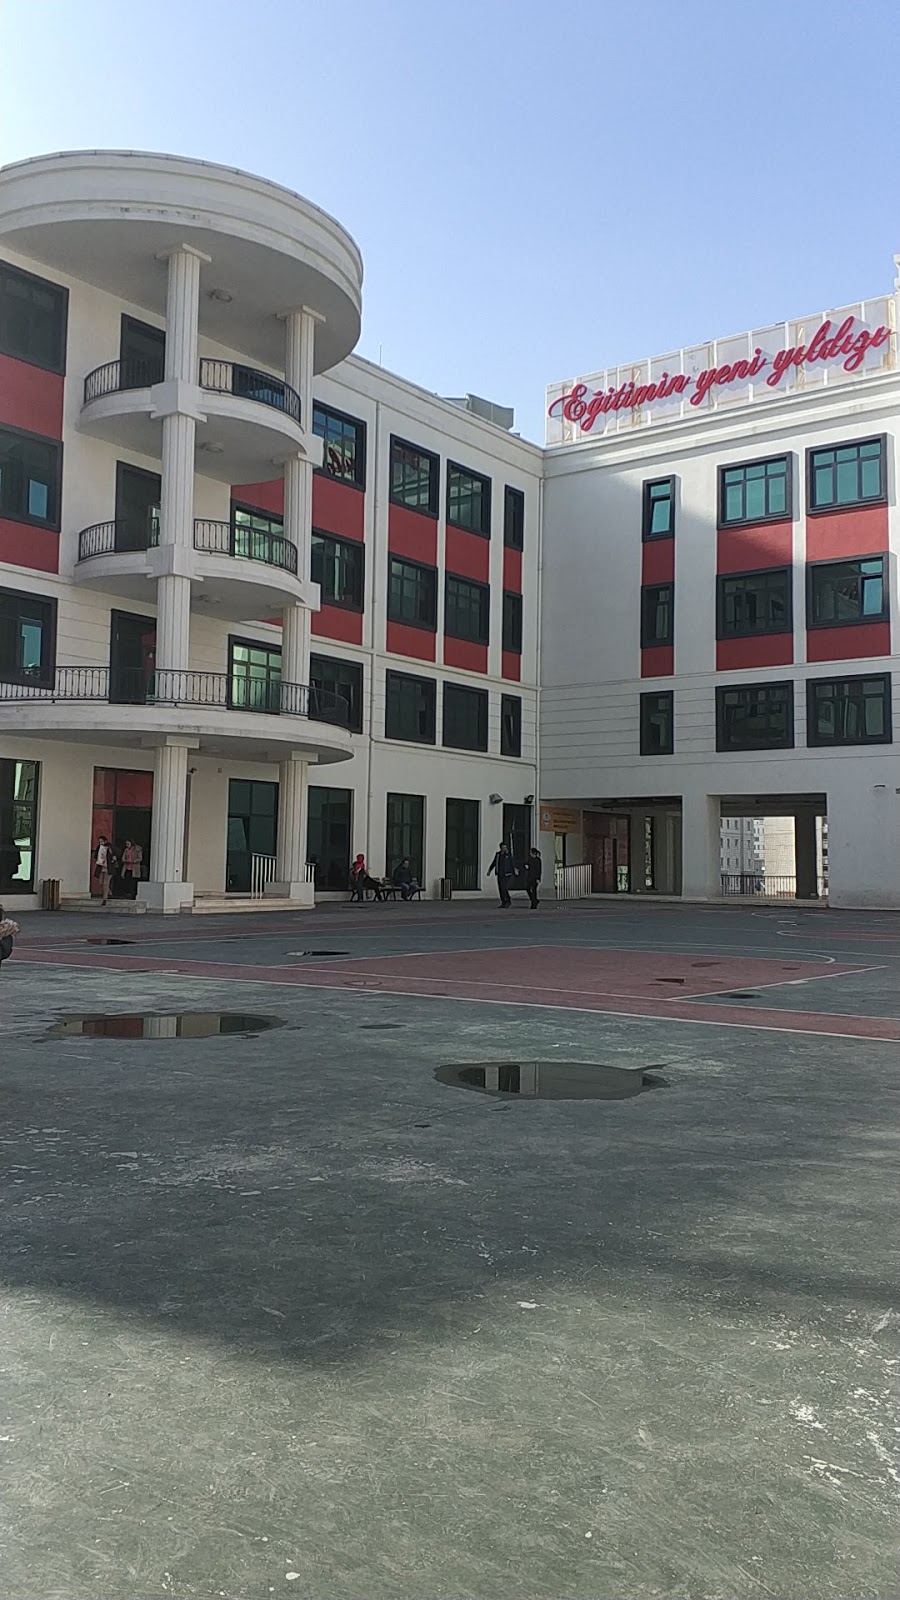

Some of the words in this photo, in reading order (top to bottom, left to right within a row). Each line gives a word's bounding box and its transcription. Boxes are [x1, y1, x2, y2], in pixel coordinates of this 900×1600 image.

[548, 372, 691, 432] Eğitimin
[690, 347, 767, 406] yeni
[766, 315, 892, 387] yıldızı
